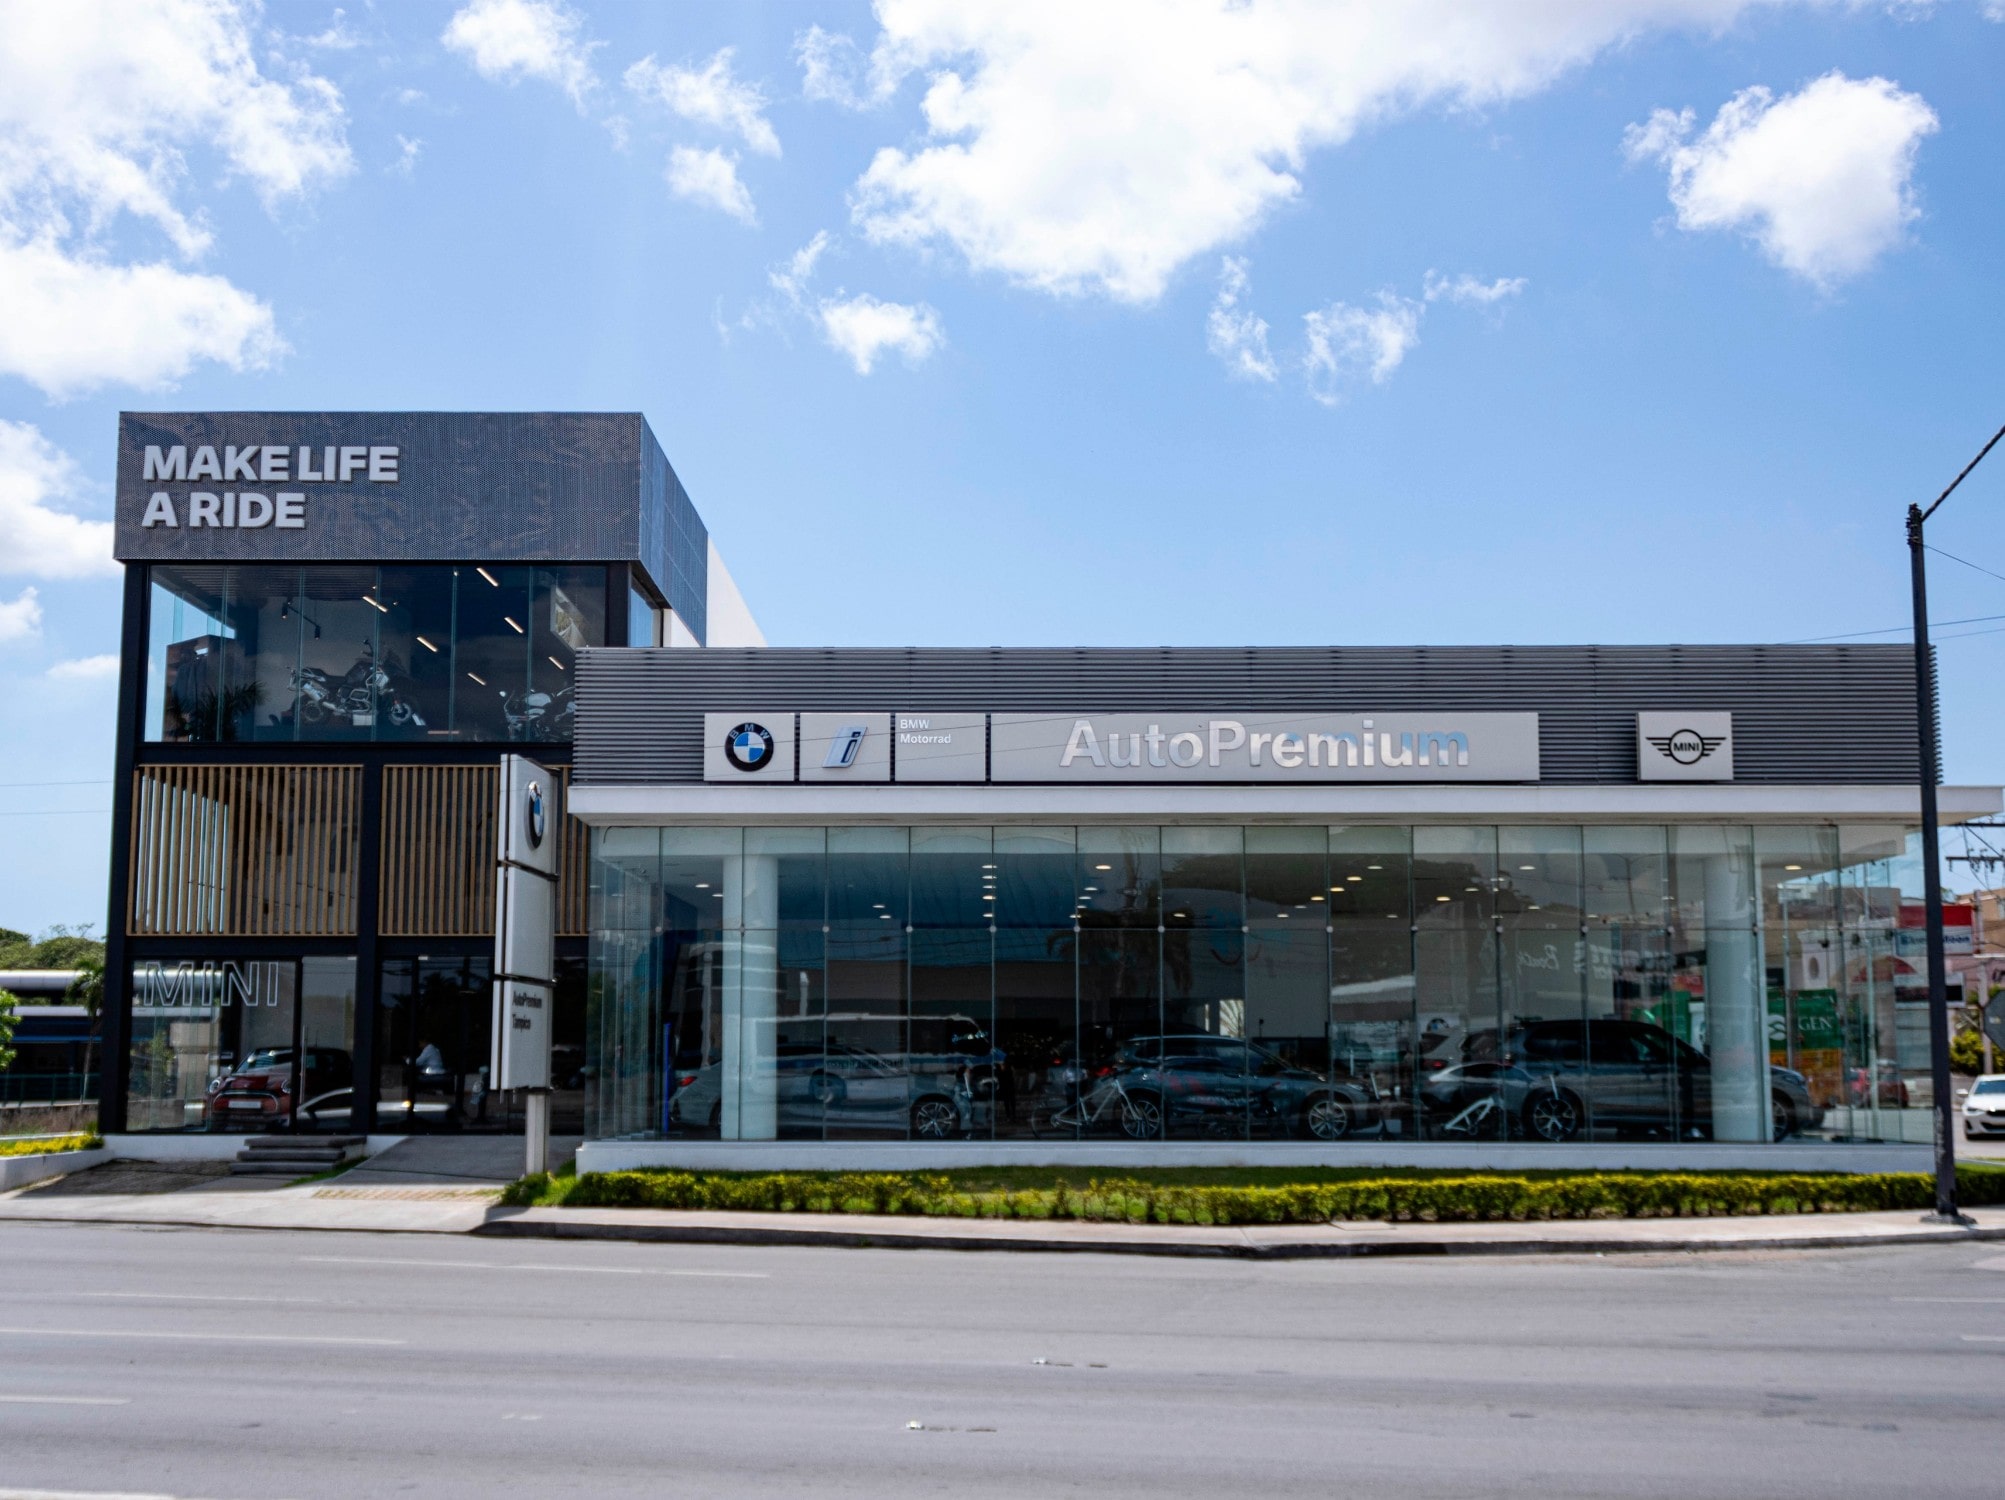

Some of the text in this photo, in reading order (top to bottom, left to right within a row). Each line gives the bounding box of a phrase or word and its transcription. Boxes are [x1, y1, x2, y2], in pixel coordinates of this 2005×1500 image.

[143, 445, 399, 482] MAKE LIFE
[142, 491, 306, 528] A RIDE
[900, 719, 930, 730] BMW
[900, 733, 952, 745] Motorrad
[1059, 719, 1469, 768] AutoPremium
[1673, 742, 1700, 752] MINI
[143, 960, 280, 1007] MINI
[512, 990, 543, 1009] AutoPremium
